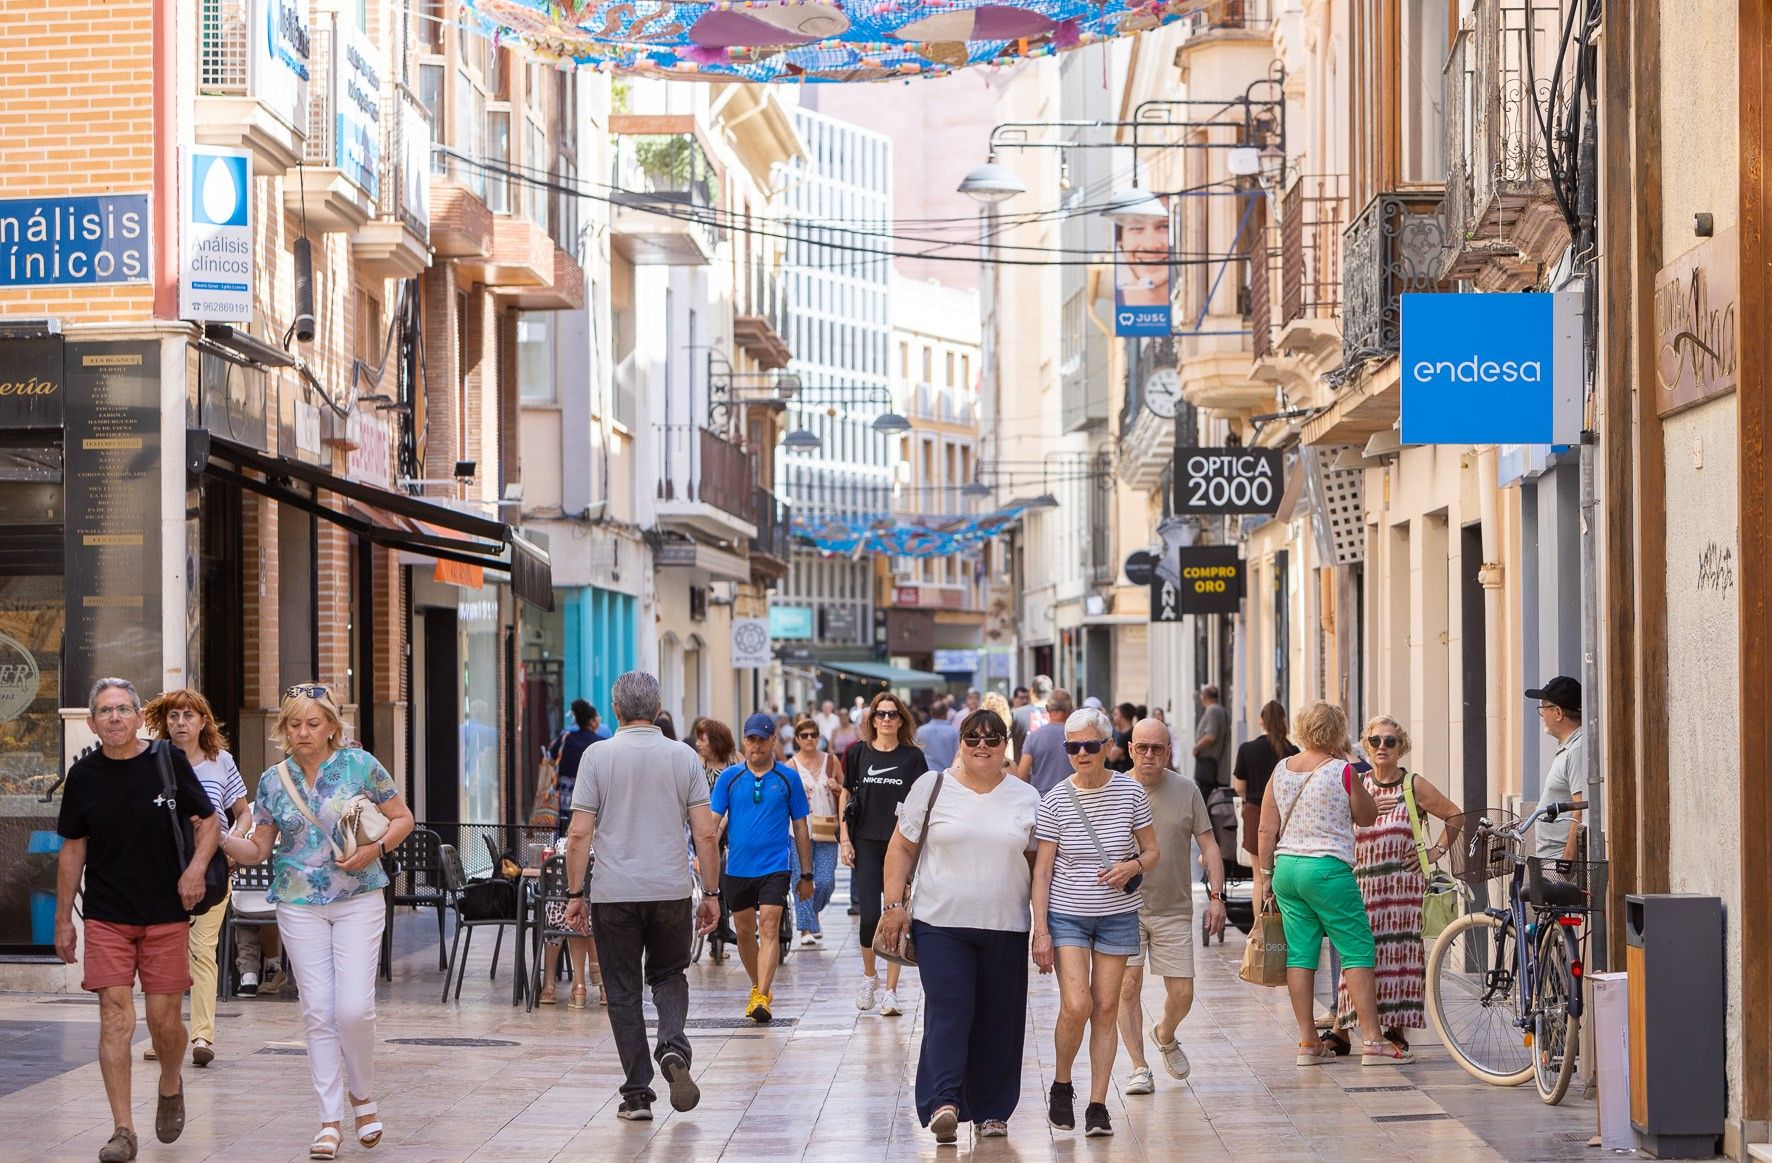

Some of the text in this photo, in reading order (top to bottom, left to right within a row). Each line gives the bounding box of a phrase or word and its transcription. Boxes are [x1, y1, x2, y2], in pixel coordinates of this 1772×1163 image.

[0, 205, 141, 242] nálisis
[192, 235, 249, 254] Análisis
[10, 244, 141, 279] ínicos
[192, 255, 249, 274] clínicos
[203, 301, 249, 313] 962869191
[1413, 354, 1541, 383] endesa
[1187, 456, 1272, 477] OPTICA
[1188, 477, 1272, 506] 2000
[1183, 567, 1236, 578] COMPRO
[1194, 580, 1226, 593] ORO
